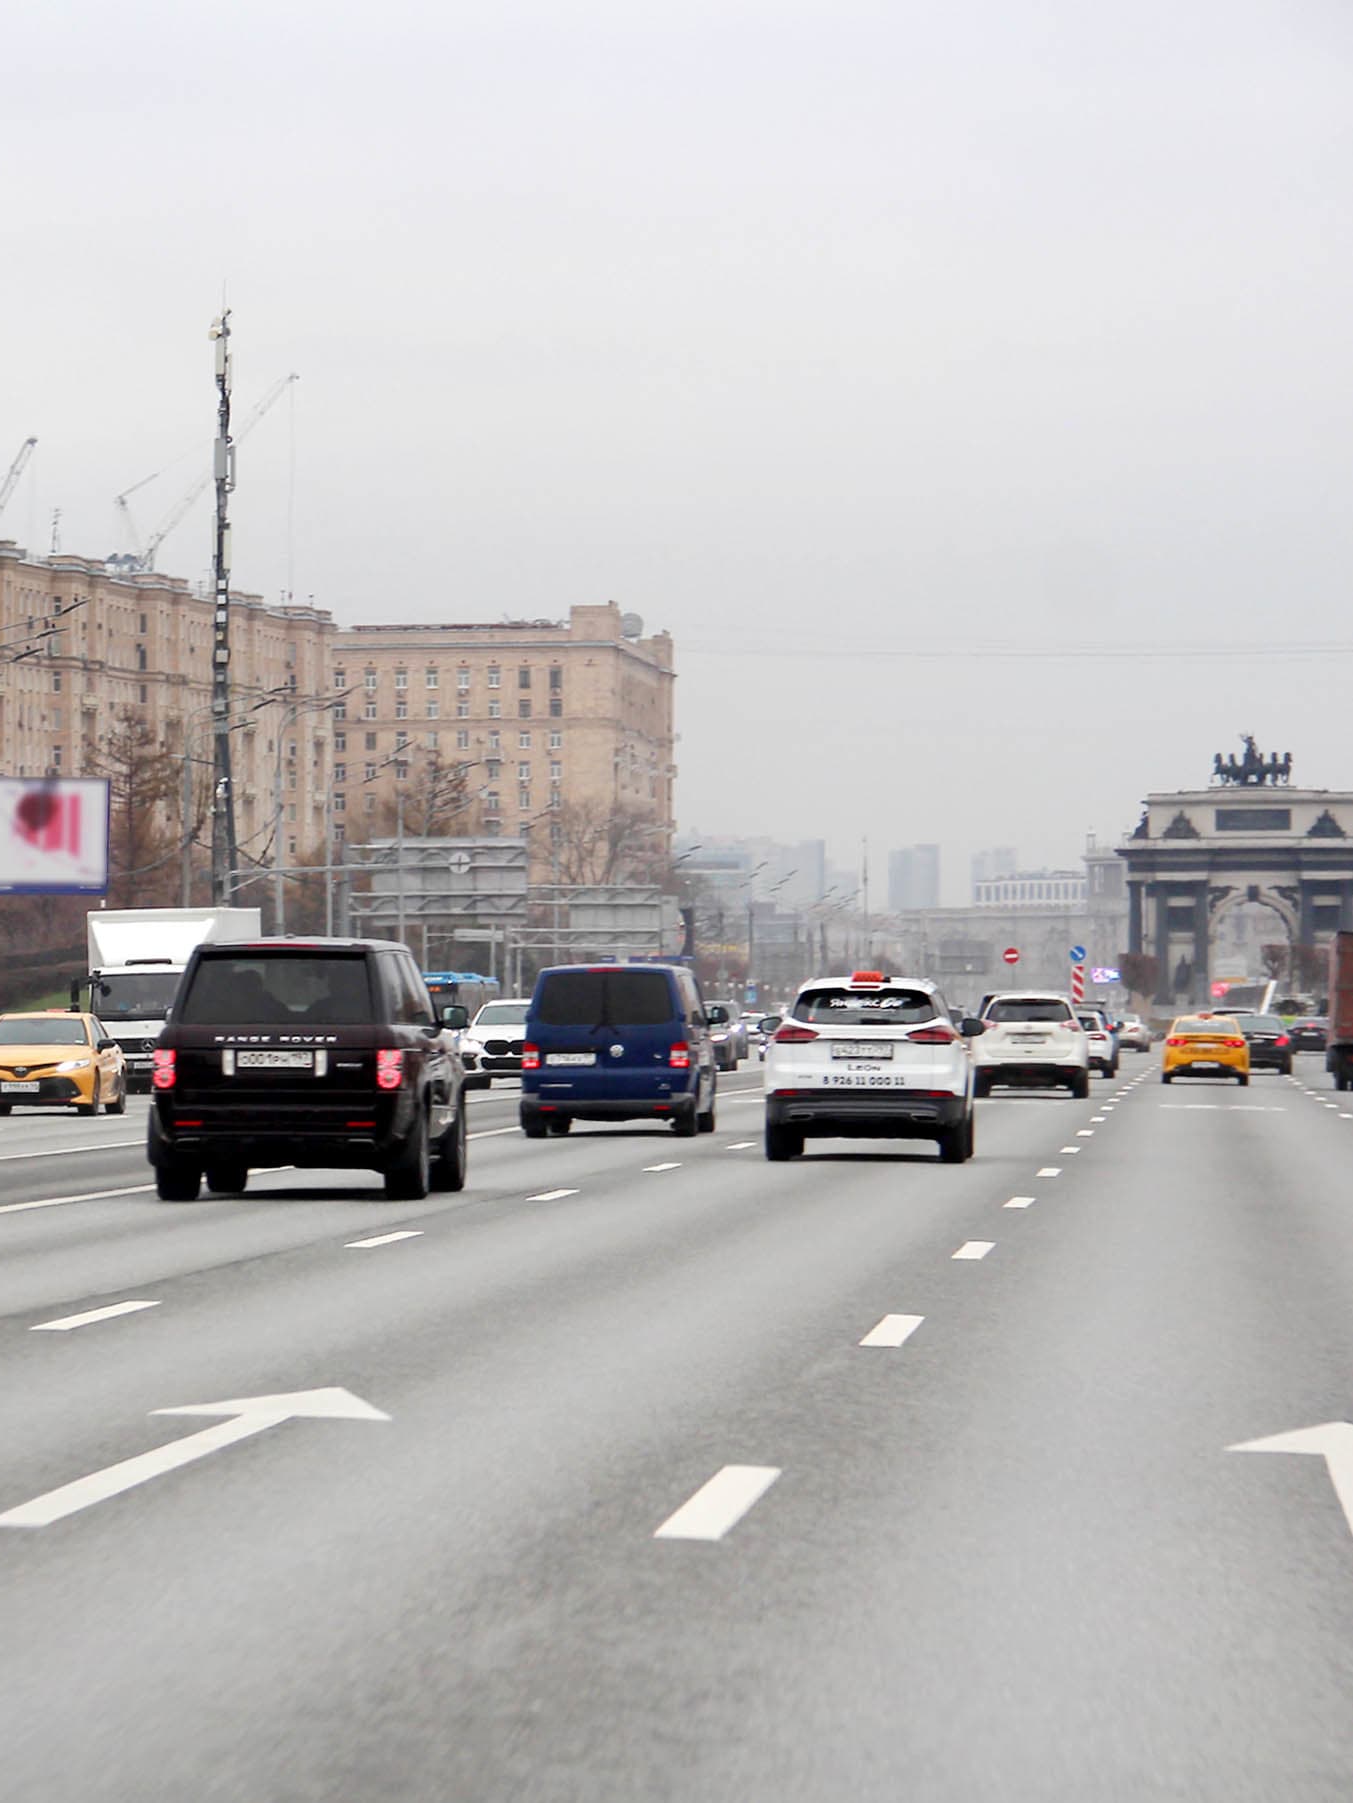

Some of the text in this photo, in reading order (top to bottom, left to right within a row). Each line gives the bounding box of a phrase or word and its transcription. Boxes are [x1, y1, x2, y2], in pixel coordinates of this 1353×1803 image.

[214, 1035, 337, 1043] RANGE ROVER
[832, 1076, 853, 1085] 926
